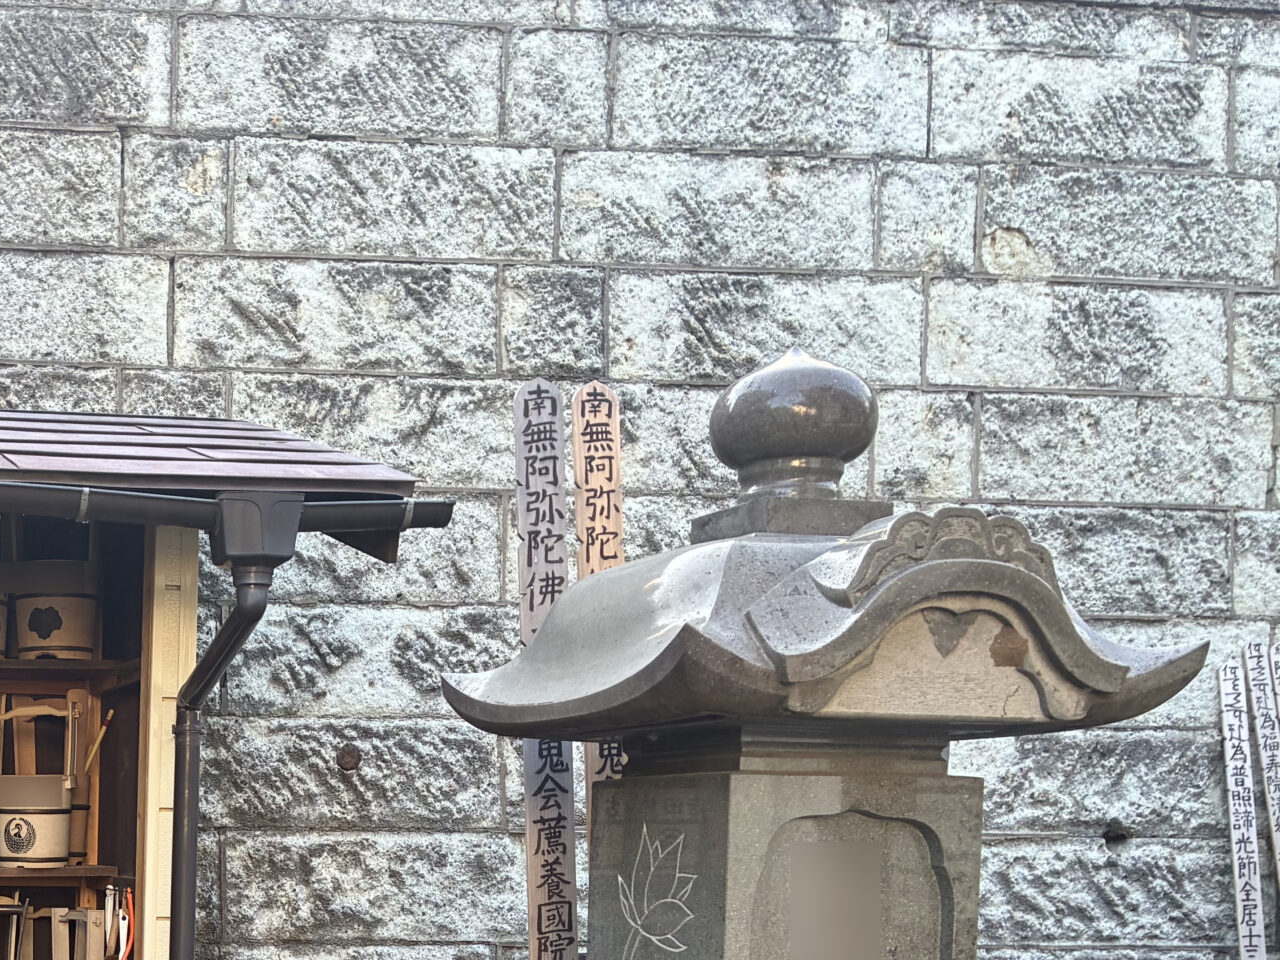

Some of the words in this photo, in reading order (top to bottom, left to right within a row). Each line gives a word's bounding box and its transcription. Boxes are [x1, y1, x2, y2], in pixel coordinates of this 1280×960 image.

[522, 384, 565, 633] 南無阿弥陀佛
[580, 387, 621, 576] 南無阿弥陀
